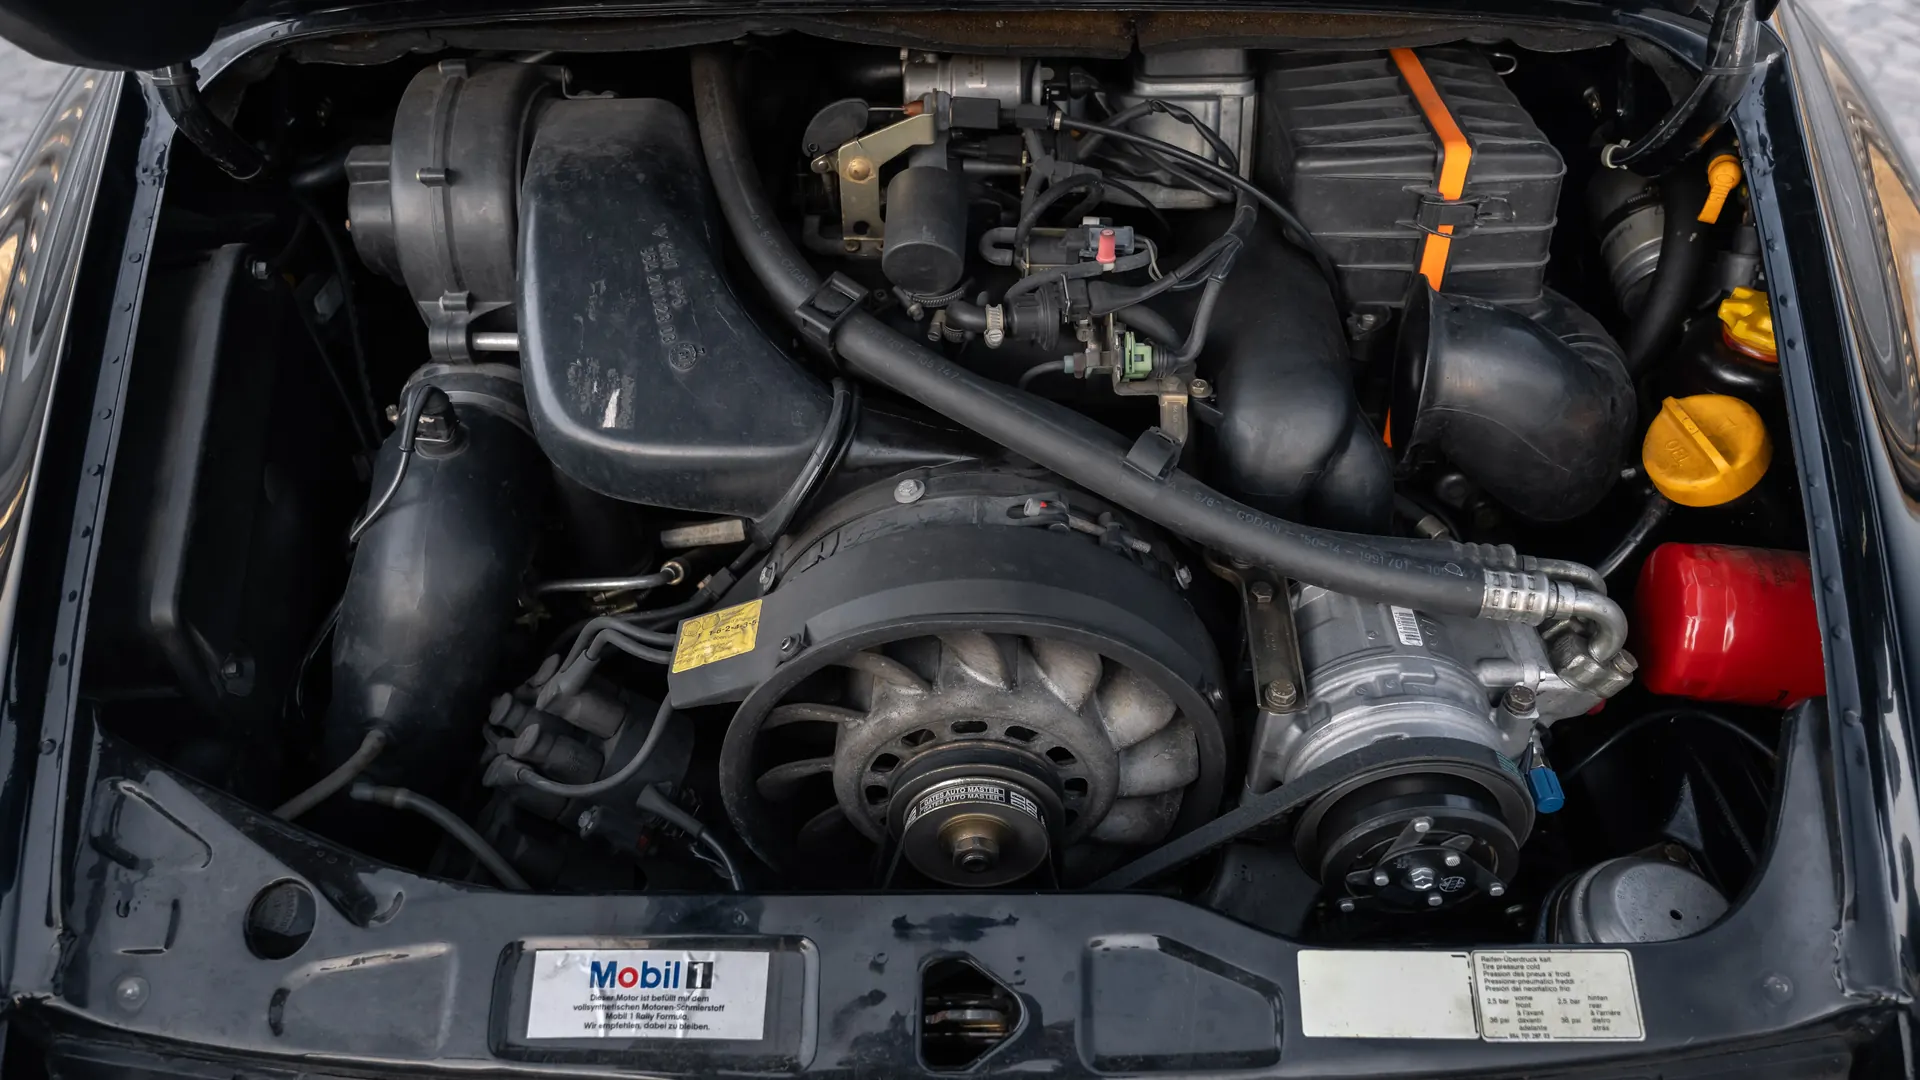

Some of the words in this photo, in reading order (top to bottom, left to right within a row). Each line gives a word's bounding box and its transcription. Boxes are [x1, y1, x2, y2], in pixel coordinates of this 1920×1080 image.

[924, 792, 944, 806] GATES
[946, 787, 965, 796] AUTO
[968, 786, 999, 794] MASTER
[945, 794, 965, 802] AUTO
[589, 960, 680, 989] Mobil
[689, 962, 709, 989] 1
[590, 994, 614, 1002] Dieser
[616, 994, 639, 1002] Motor
[640, 994, 650, 1002] ist
[651, 994, 676, 1002] befüllt
[678, 994, 690, 1002] mit
[692, 994, 710, 1002] dem
[573, 1004, 640, 1013] vollsynthetischen
[642, 1004, 725, 1012] Motoren-Schmierstoff
[606, 1012, 628, 1020] Mobil
[636, 1012, 654, 1022] Rally
[584, 1022, 597, 1030] Wir
[644, 1022, 666, 1030] dabei
